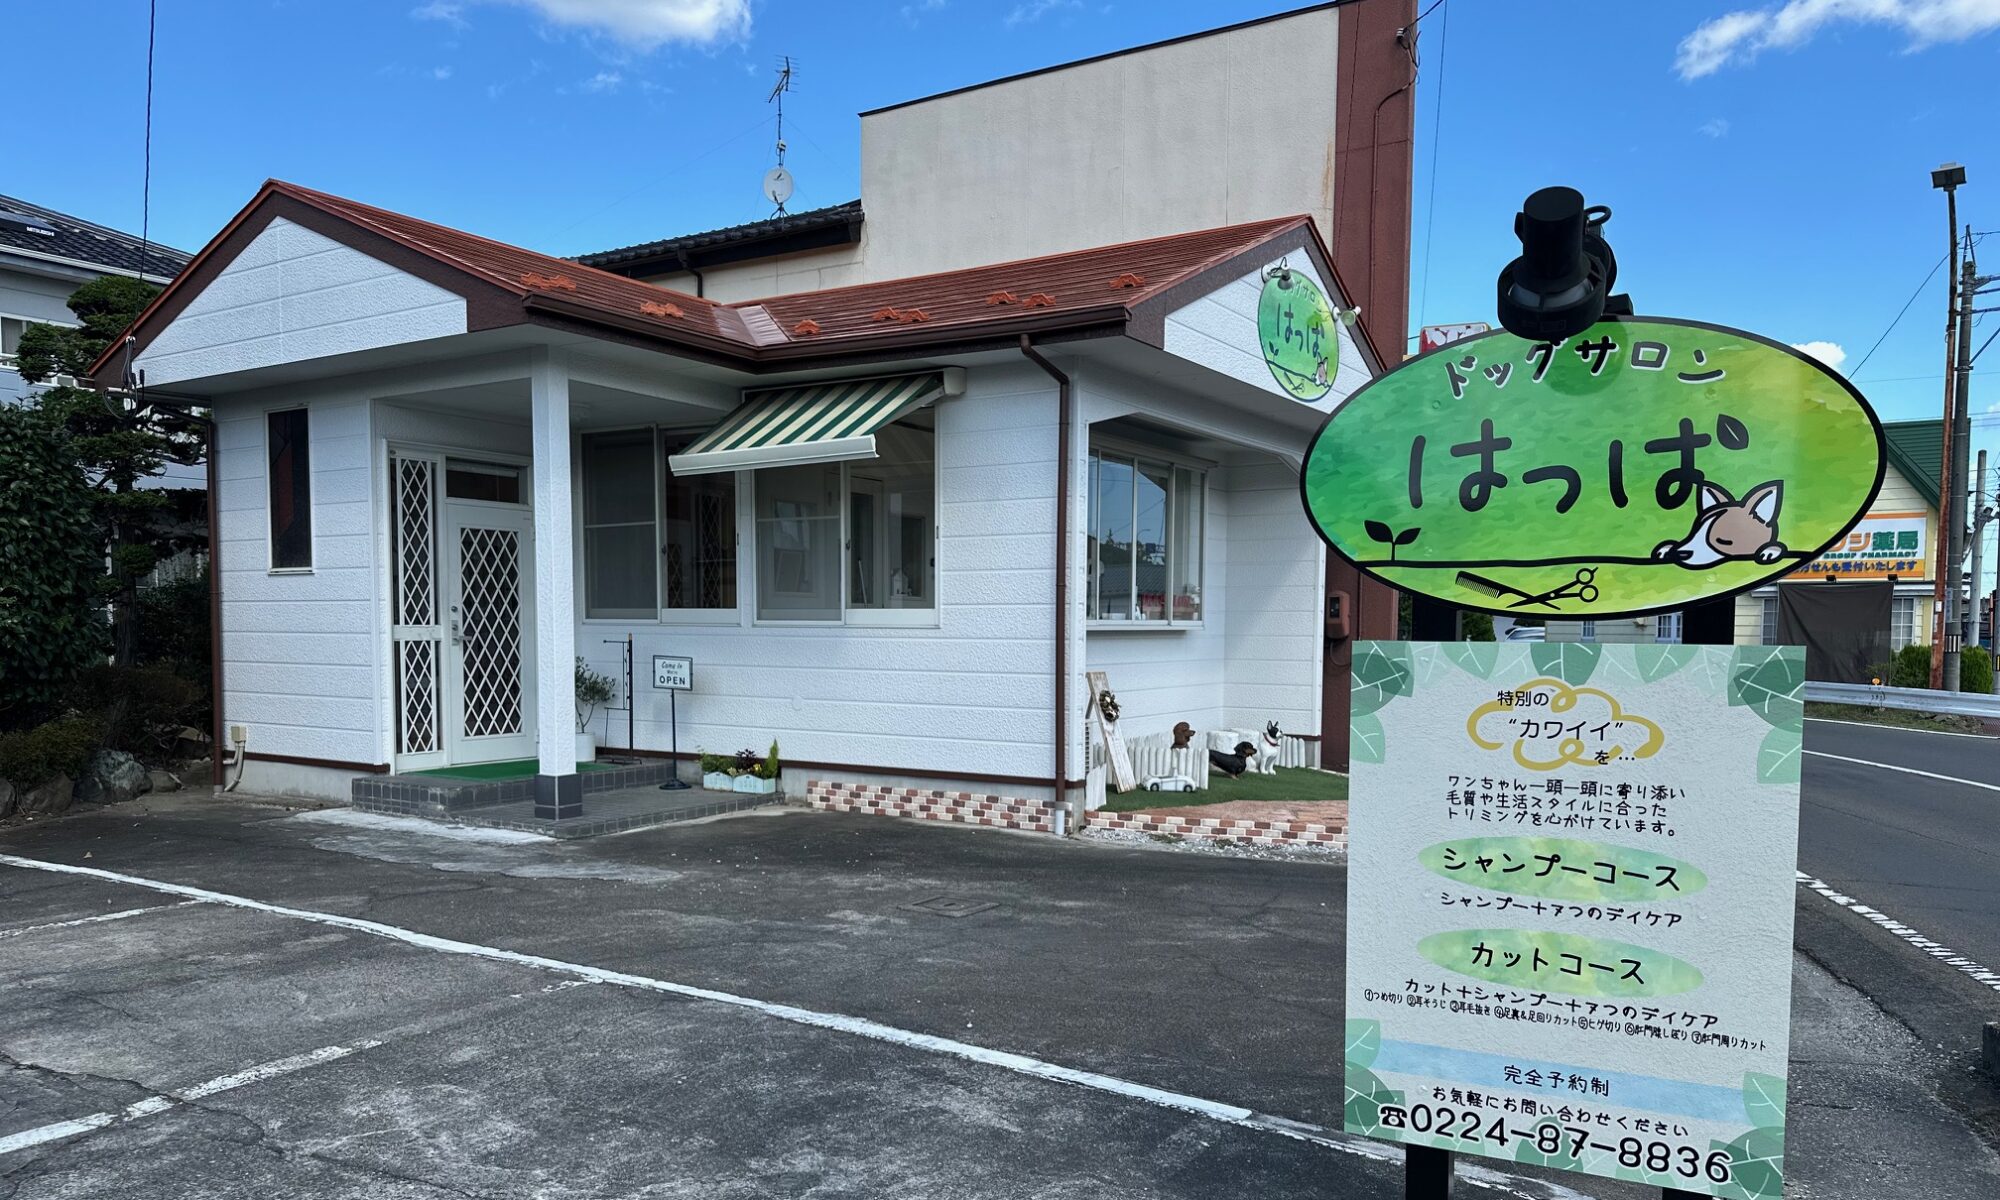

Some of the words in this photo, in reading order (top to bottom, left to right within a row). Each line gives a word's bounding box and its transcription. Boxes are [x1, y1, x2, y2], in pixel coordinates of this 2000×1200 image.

[1276, 303, 1325, 358] はっぱ
[1444, 335, 1726, 400] ドッグサロン
[1408, 413, 1750, 513] はっぱ
[1861, 551, 1918, 559] PHARMACY
[659, 675, 686, 685] OPEN
[1497, 690, 1549, 707] 特別の
[1446, 789, 1667, 818] 毛質や生活スタイルに合った
[1448, 807, 1676, 837] トリミングを心がけています。
[1443, 848, 1681, 891] シャンプーコース
[1470, 941, 1645, 985] カットコース
[1503, 1065, 1610, 1097] 完全予約制
[1432, 1086, 1689, 1137] お気軽にお問い合わせください
